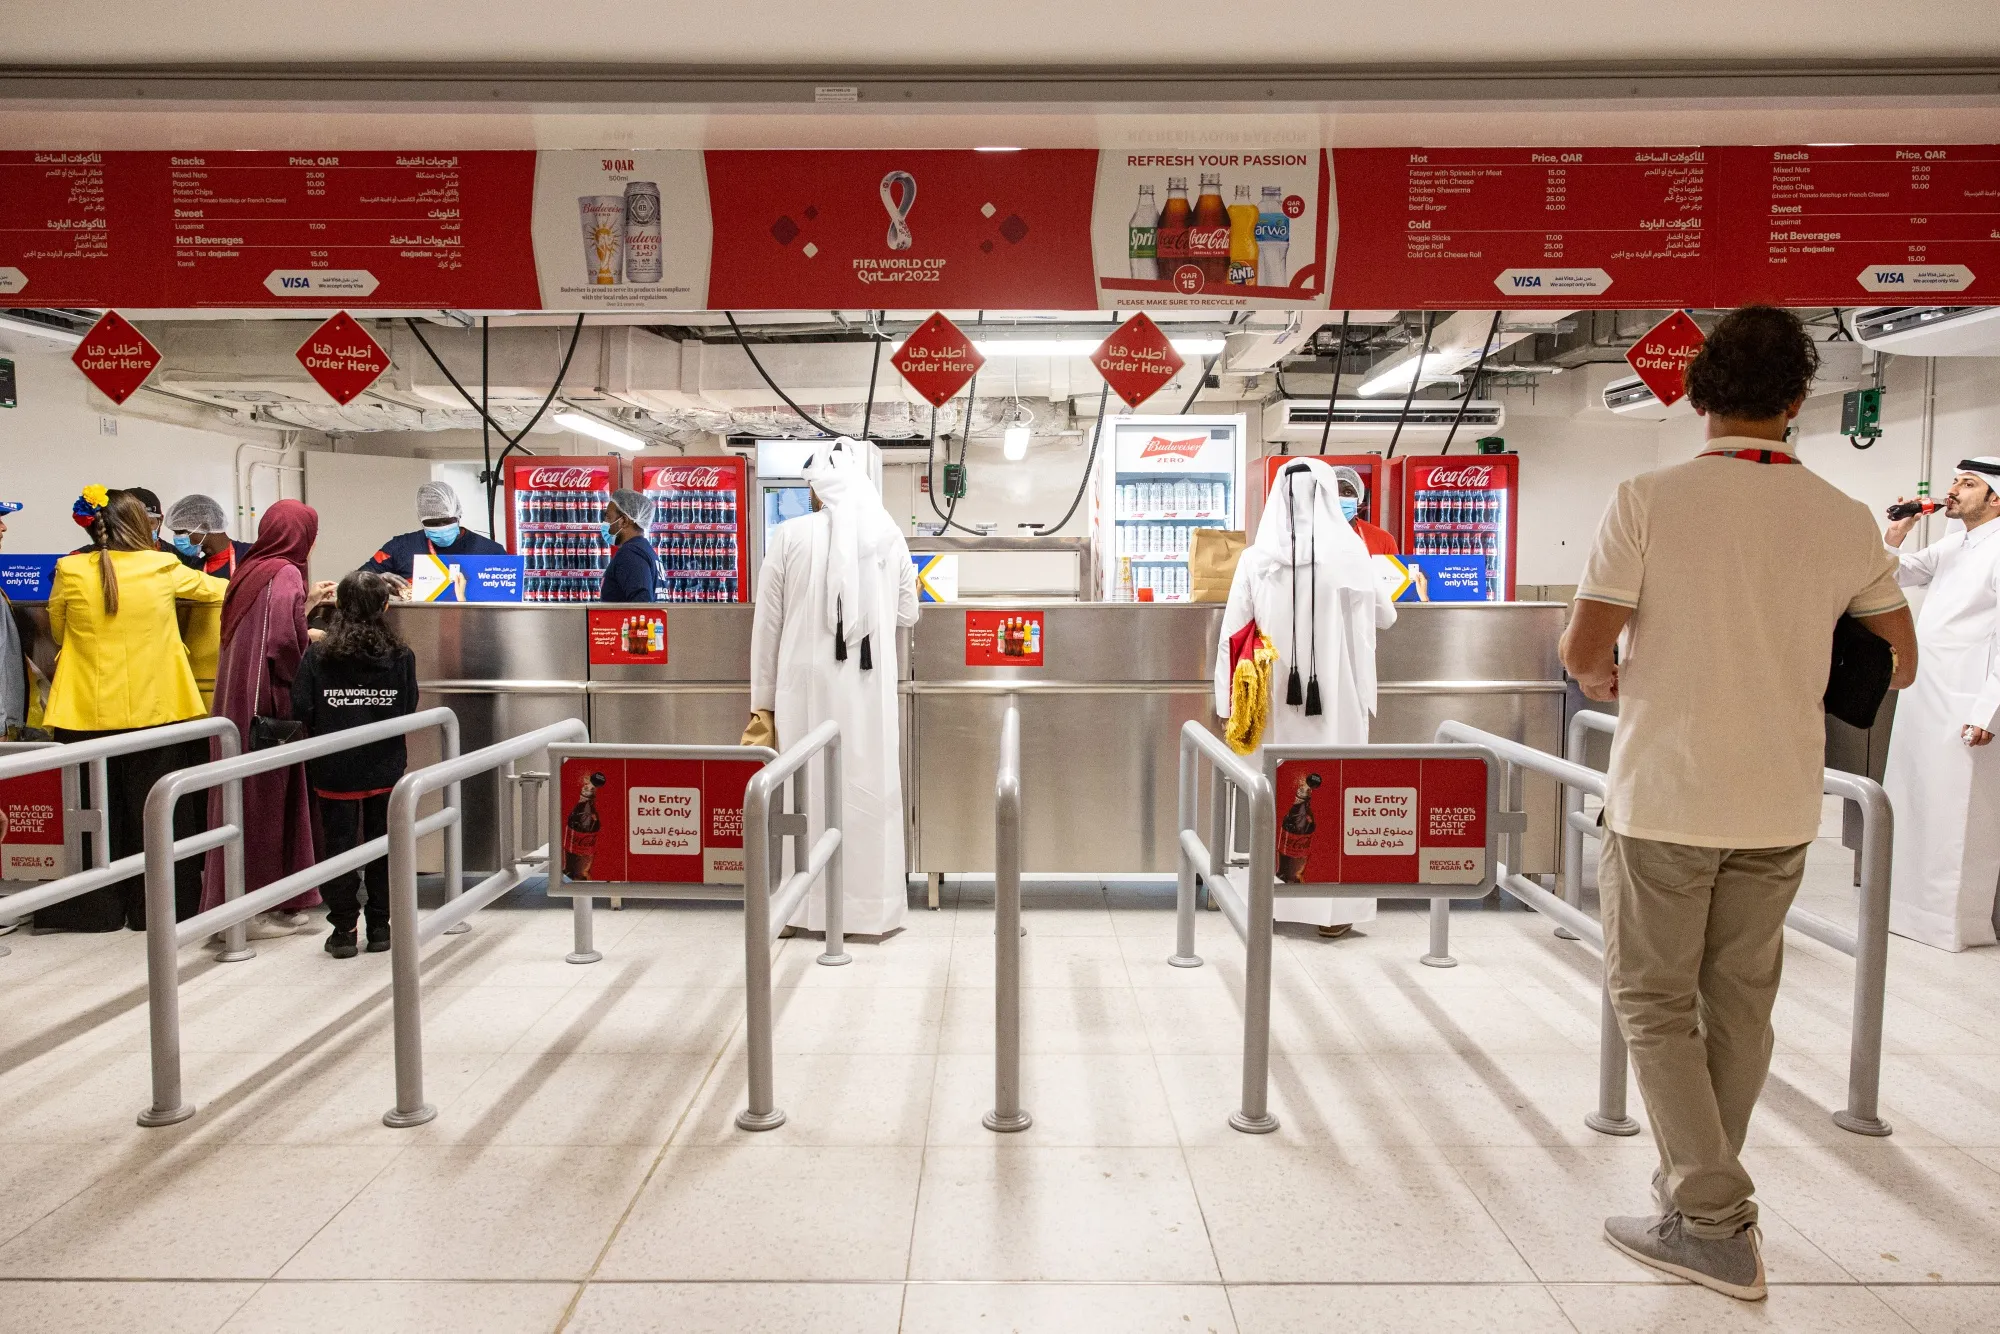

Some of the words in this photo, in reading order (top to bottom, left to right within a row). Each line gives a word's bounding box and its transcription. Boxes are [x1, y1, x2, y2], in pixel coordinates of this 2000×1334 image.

[1128, 156, 1194, 166] REFRESH
[1199, 156, 1238, 166] YOUR
[1243, 155, 1306, 165] PASSION
[1532, 154, 1558, 163] Price,
[1561, 154, 1582, 162] QAR
[1635, 153, 1668, 162] الساخنة
[1670, 151, 1704, 163] المأكولات
[1774, 152, 1809, 160] Snacks
[1896, 151, 1922, 160] Price,
[1925, 150, 1946, 159] QAR
[171, 157, 205, 166] Snacks
[289, 157, 316, 167] Price,
[317, 157, 339, 166] QAR
[602, 160, 612, 170] 30
[615, 160, 634, 171] QAR
[174, 209, 204, 218] Sweet
[583, 202, 624, 214] Budweiser
[1772, 205, 1801, 213] Sweet
[1408, 221, 1430, 229] Cold
[1640, 219, 1664, 229] الباردة
[1666, 218, 1701, 229] المأكولات
[1255, 224, 1286, 236] arwa
[1131, 230, 1156, 247] Spri
[1189, 228, 1230, 250] Coca-Cola
[853, 259, 877, 268] FIFA
[880, 259, 921, 268] WORLD
[923, 259, 946, 268] CUP
[858, 270, 939, 284] Qatar2022
[1229, 266, 1255, 280] FANTA
[1874, 273, 1904, 283] VISA
[280, 278, 310, 288] VISA
[1183, 280, 1195, 288] 15
[1513, 277, 1541, 286] VISA
[87, 345, 105, 356] هنا
[110, 342, 142, 360] أطلب
[314, 343, 333, 356] هنا
[335, 346, 371, 360] أطلب
[909, 347, 928, 358] هنا
[931, 346, 966, 361] أطلب
[1109, 346, 1128, 357] هنا
[1131, 346, 1166, 361] أطلب
[1646, 343, 1665, 354] هنا
[82, 358, 118, 370] Order
[121, 358, 151, 369] Here
[306, 357, 346, 371] Order
[348, 361, 379, 372] Here
[902, 361, 940, 372] Order
[943, 361, 974, 372] Here
[1100, 359, 1138, 372] Order
[1142, 363, 1173, 374] Here
[1636, 357, 1675, 369] Order
[1146, 440, 1201, 452] Budweiser
[529, 467, 594, 488] Coca-Cola
[657, 466, 721, 487] Coca-Cola
[1428, 466, 1493, 487] Coca-Cola
[328, 698, 393, 707] Qatar2022
[639, 795, 655, 803] No
[659, 795, 691, 806] Entry
[1355, 795, 1370, 804] No
[1375, 795, 1408, 806] Entry
[638, 808, 661, 816] Exit
[664, 808, 691, 818] Only
[1353, 808, 1376, 817] Exit
[1380, 808, 1408, 818] Only
[633, 827, 665, 837] الدخول
[668, 827, 698, 836] ممنوع
[1347, 827, 1381, 837] الدخول
[1383, 827, 1413, 836] ممنوع
[642, 837, 663, 846] فقط
[666, 838, 688, 848] خروج
[1356, 838, 1379, 847] فقط
[1381, 839, 1404, 847] خروج
